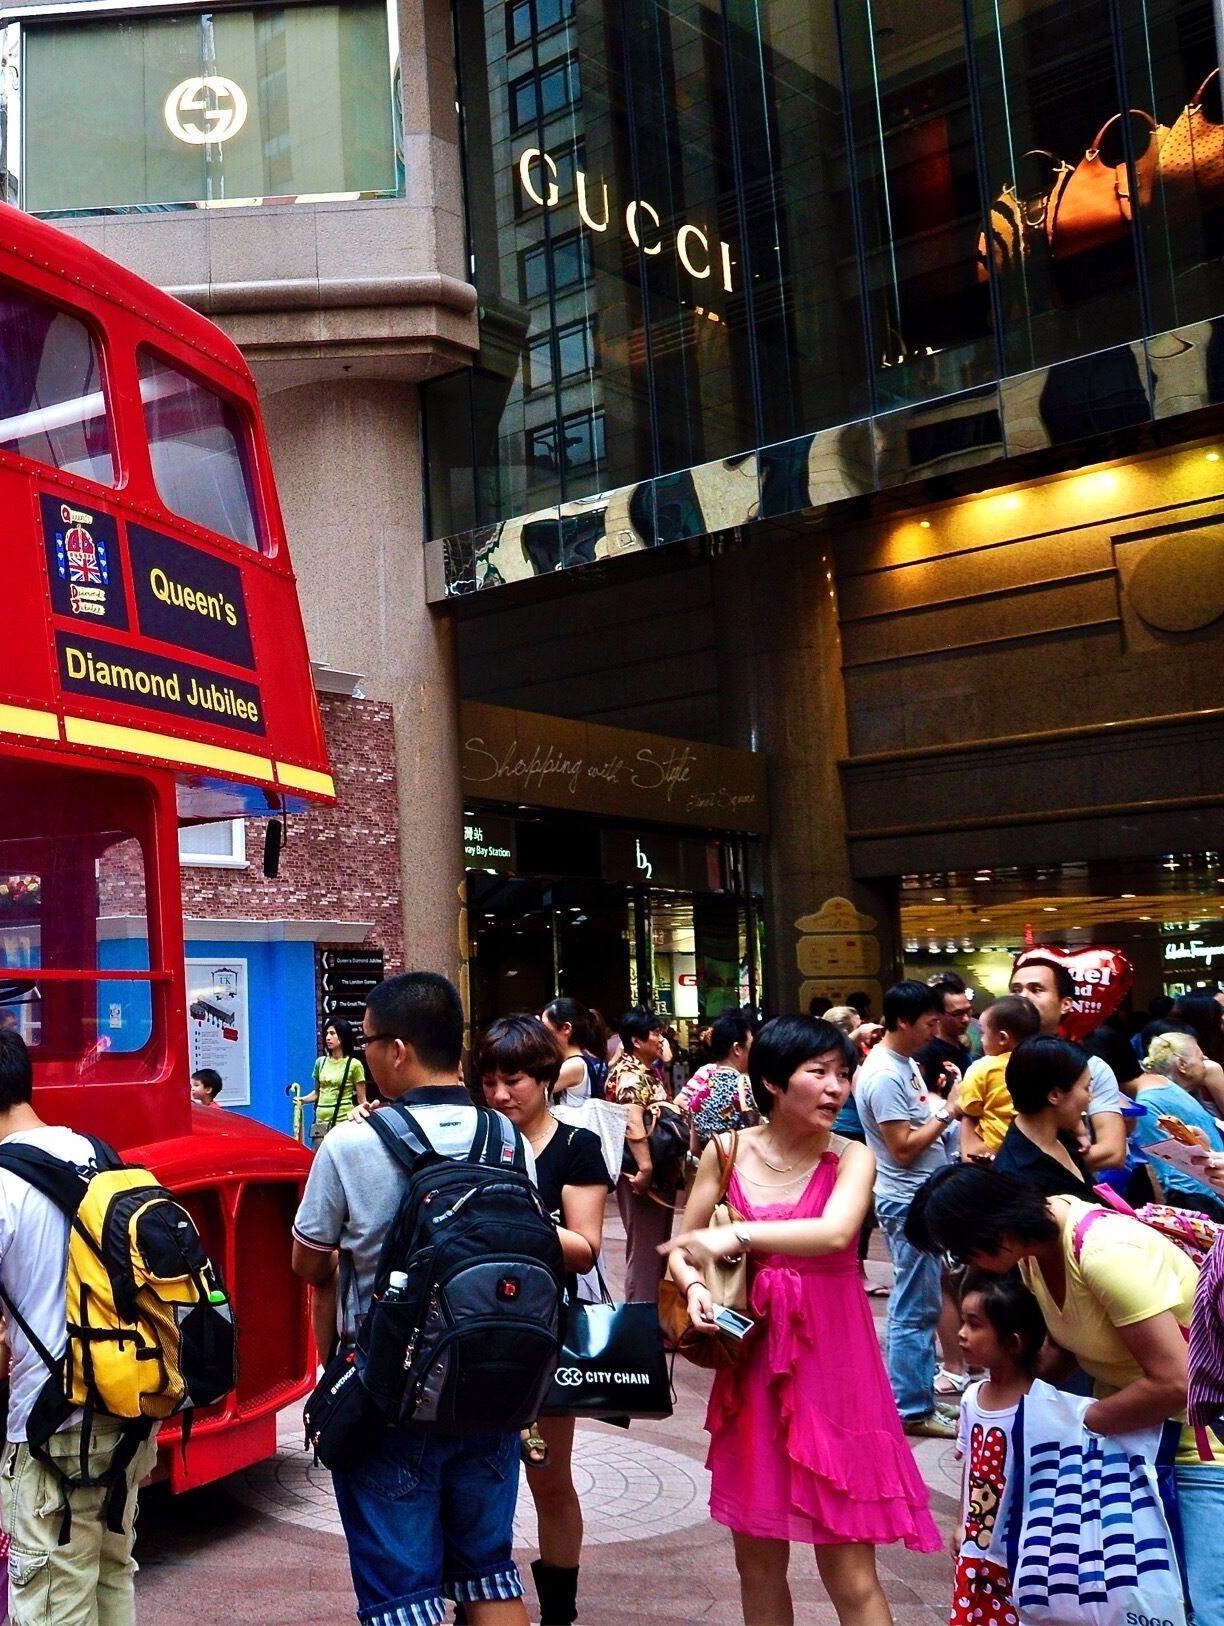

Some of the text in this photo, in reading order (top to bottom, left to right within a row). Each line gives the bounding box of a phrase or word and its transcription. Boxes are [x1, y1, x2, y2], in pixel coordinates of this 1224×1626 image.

[520, 149, 733, 292] GUCCI
[150, 567, 238, 627] Queen's
[66, 647, 259, 722] Diamond Jubilee
[463, 738, 696, 801] Shopping with Style
[476, 845, 488, 857] Bay
[488, 846, 511, 857] Station
[219, 976, 232, 986] UK
[585, 1371, 650, 1385] CITY CHAIN
